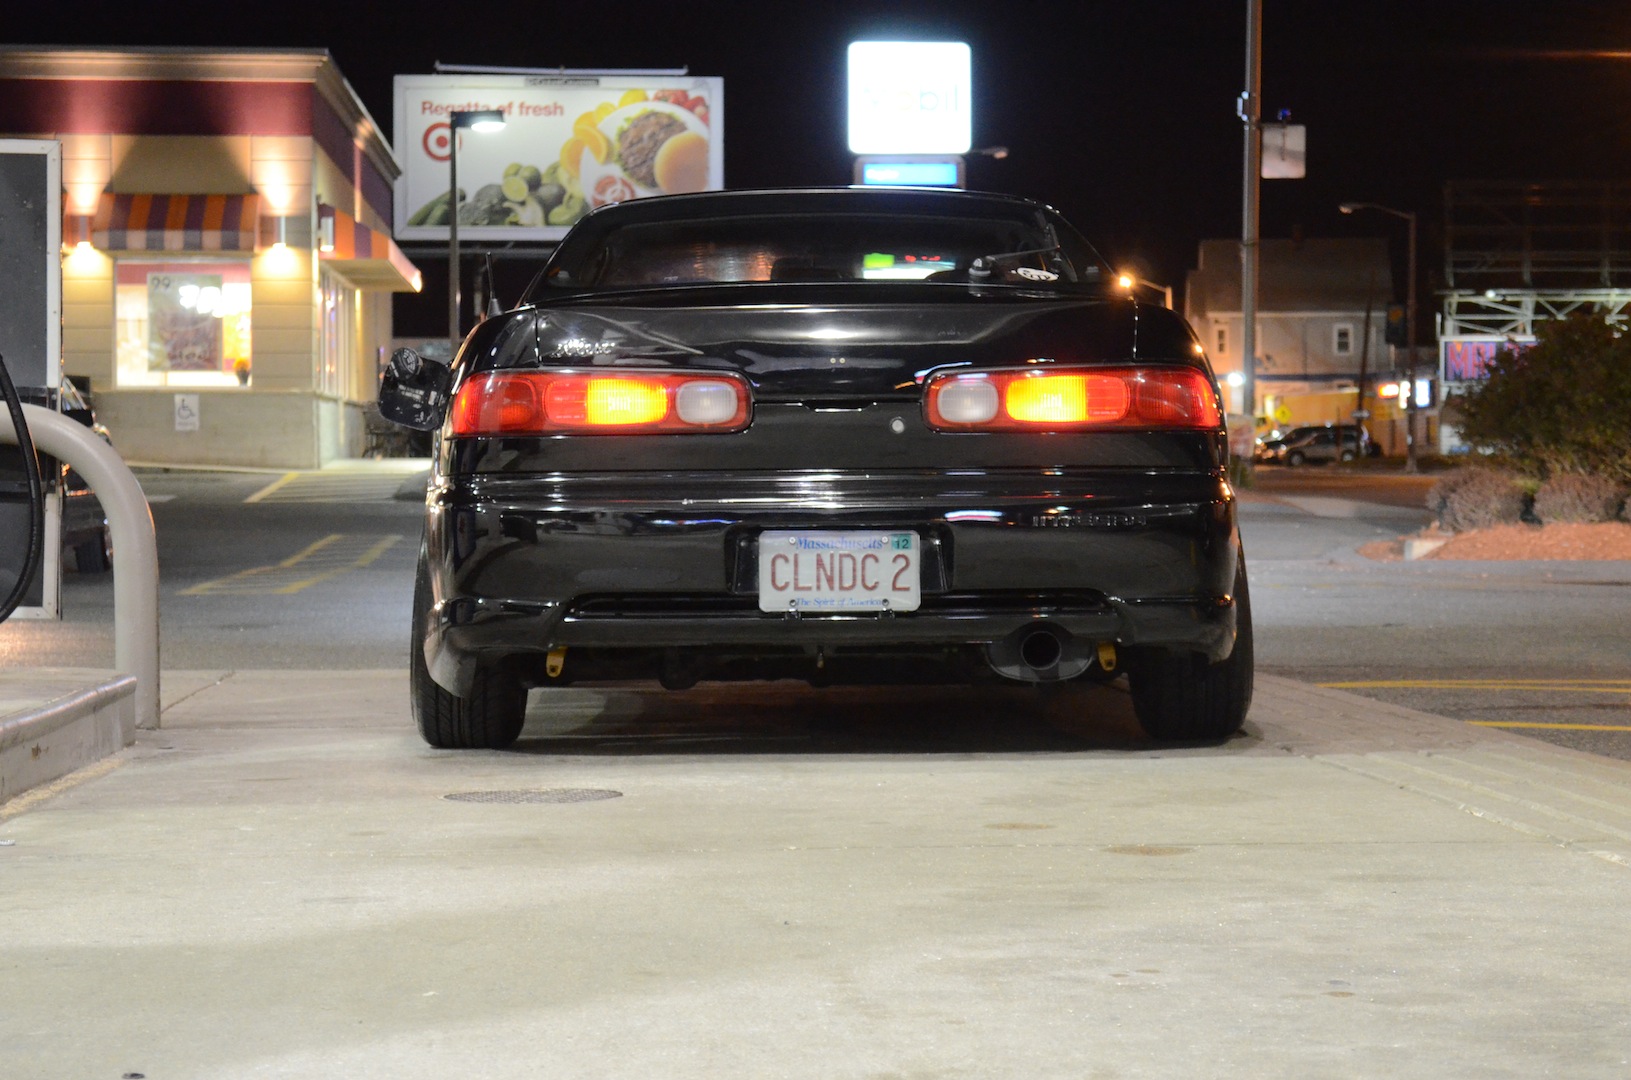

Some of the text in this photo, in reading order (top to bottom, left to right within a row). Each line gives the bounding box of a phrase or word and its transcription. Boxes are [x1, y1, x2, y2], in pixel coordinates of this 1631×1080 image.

[421, 101, 564, 117] Regatta of fresh
[796, 536, 883, 550] Massachusetts
[895, 538, 910, 550] 12
[770, 553, 911, 592] CLNDC 2
[797, 598, 810, 607] The
[812, 598, 835, 608] Spirit
[847, 598, 883, 607] America
